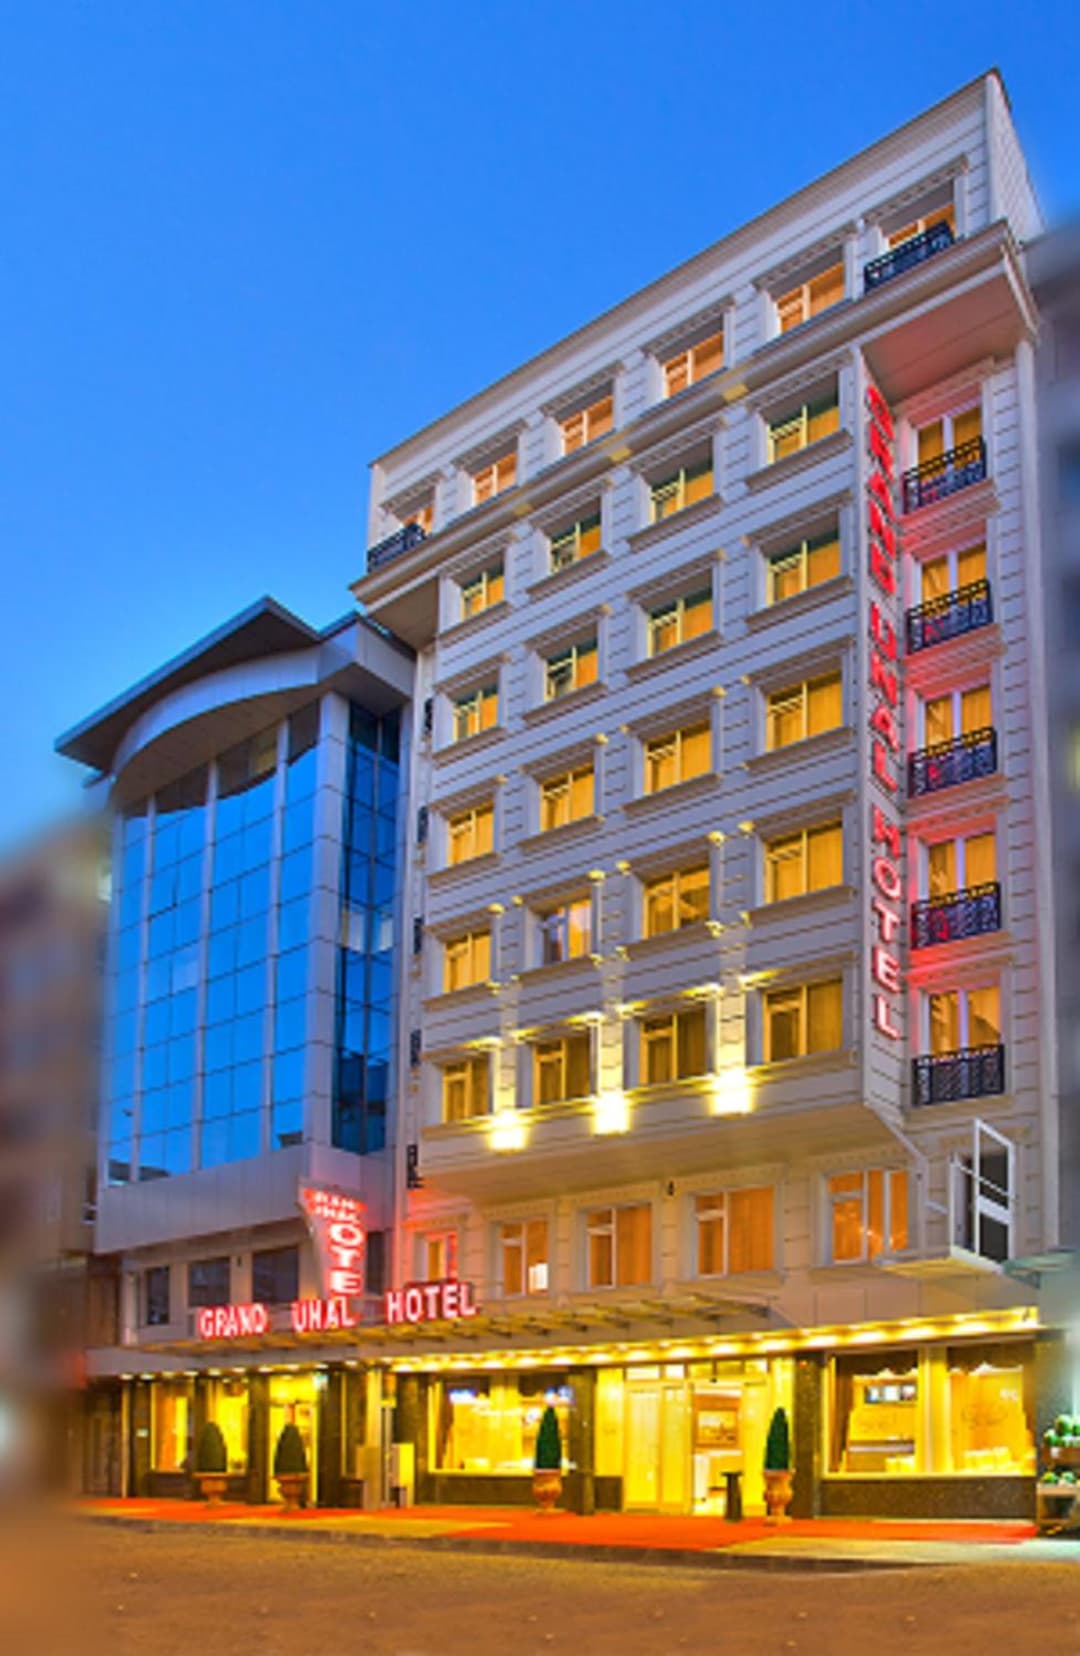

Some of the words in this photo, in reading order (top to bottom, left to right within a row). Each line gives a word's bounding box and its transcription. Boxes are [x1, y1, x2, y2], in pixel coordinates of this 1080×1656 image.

[871, 803, 902, 1040] HOTEL
[199, 1302, 268, 1337] GRAND
[386, 1284, 477, 1324] HOTEL
